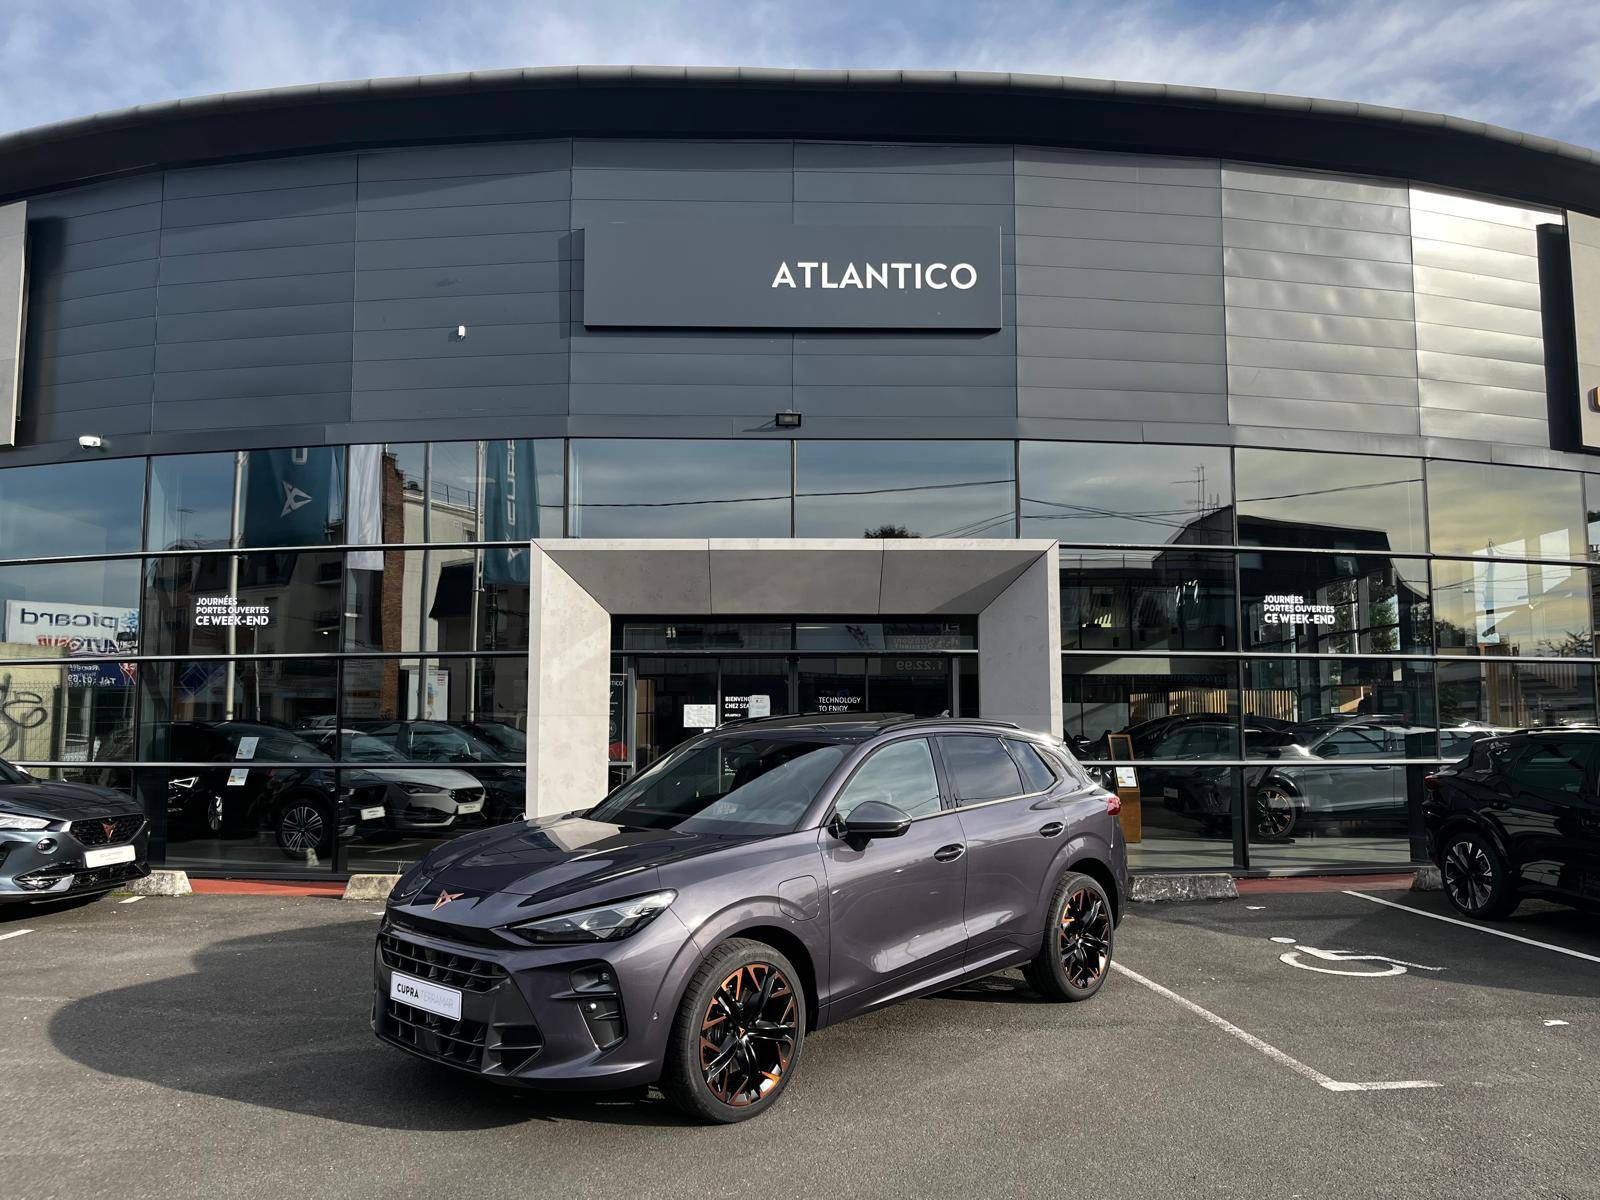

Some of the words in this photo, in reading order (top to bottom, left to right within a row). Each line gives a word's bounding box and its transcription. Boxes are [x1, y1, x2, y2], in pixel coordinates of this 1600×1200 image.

[771, 260, 978, 290] ATLANTICO
[196, 595, 238, 606] JOURNÉES
[1263, 594, 1304, 604] JOURNÉES
[196, 606, 227, 614] PORTES
[227, 606, 270, 614] OUVERTES
[1263, 604, 1294, 612] PORTES
[1295, 604, 1336, 613] OUVERTES
[195, 615, 210, 626] CE
[211, 615, 270, 626] WEEK-END
[1264, 613, 1278, 623] CE
[1279, 613, 1336, 624] WEEK-END
[818, 696, 861, 704] TECHNOLOGY
[396, 983, 419, 999] CUPRA
